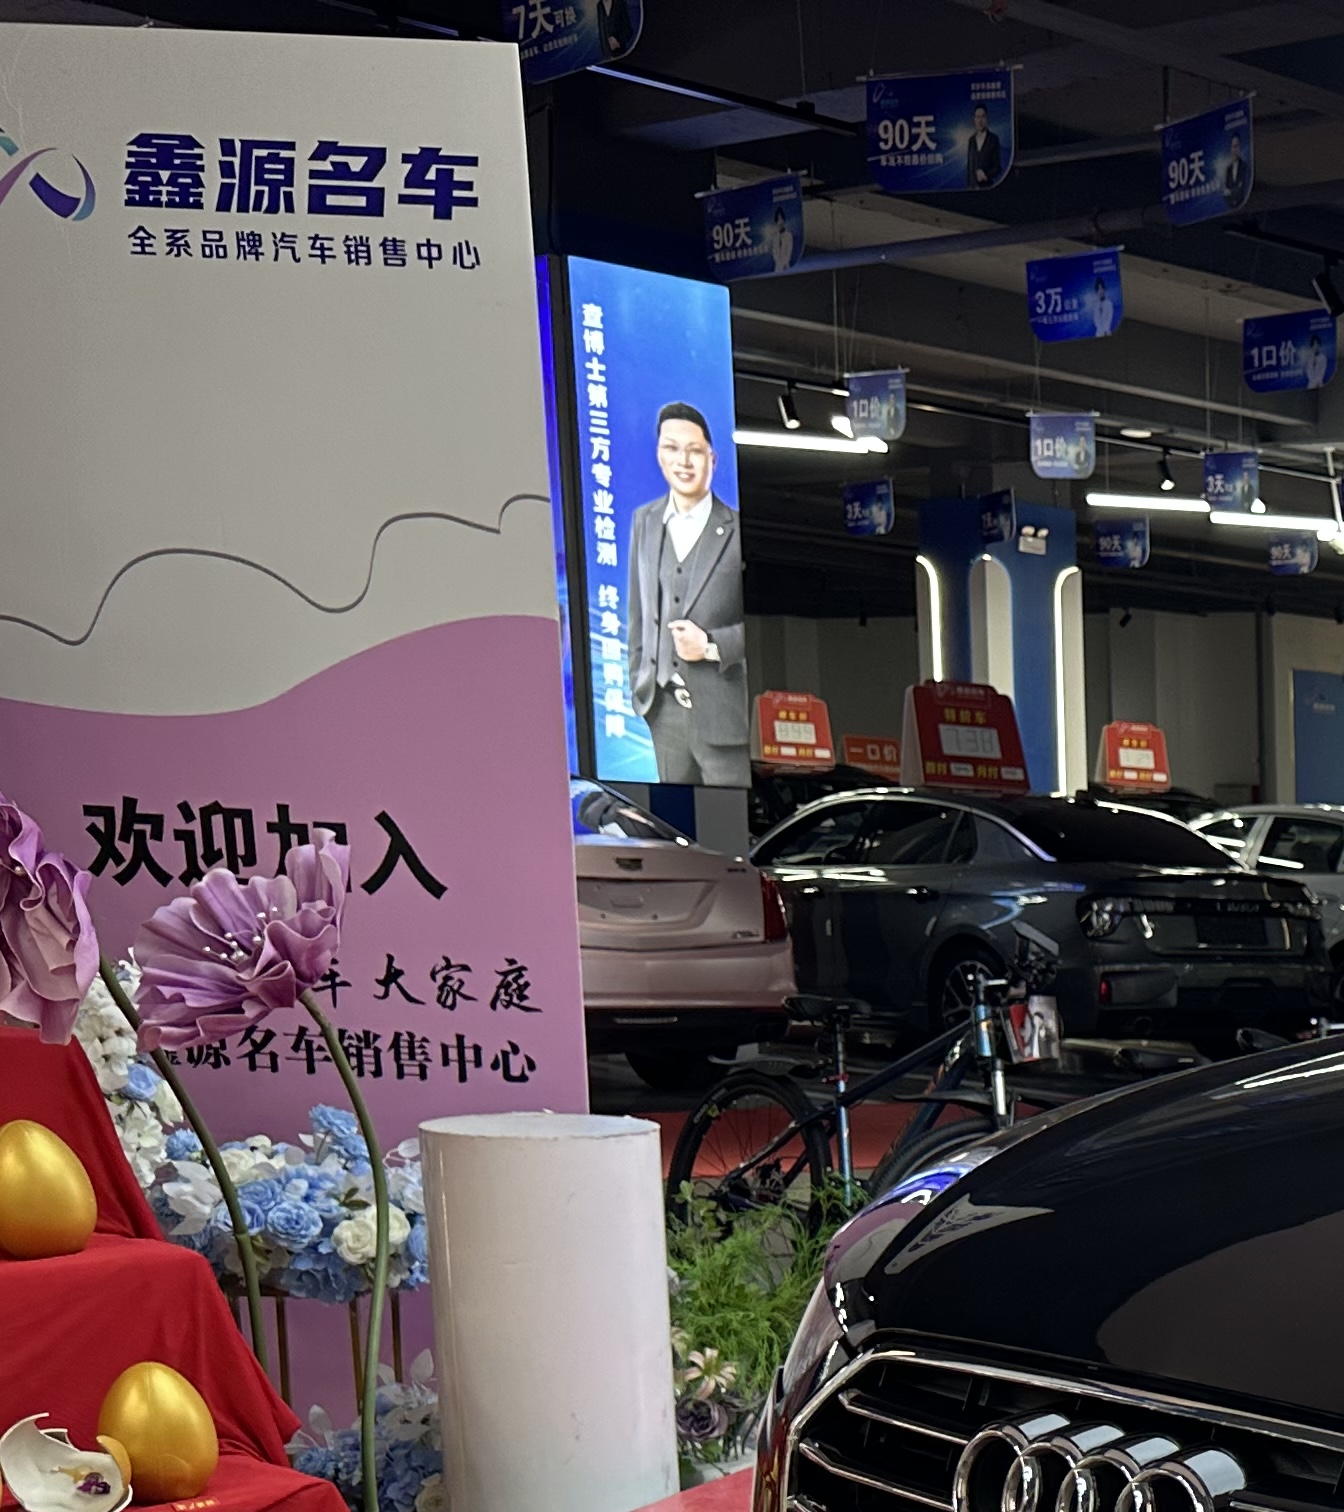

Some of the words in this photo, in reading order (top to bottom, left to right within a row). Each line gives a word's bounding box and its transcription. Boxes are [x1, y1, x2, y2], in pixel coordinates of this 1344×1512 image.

[878, 115, 937, 151] 90天
[124, 132, 480, 221] 鑫源名车
[1168, 150, 1205, 189] 90天
[127, 226, 482, 271] 全系品牌汽车销售中心
[712, 217, 753, 250] 90天
[1251, 340, 1297, 368] 1口价
